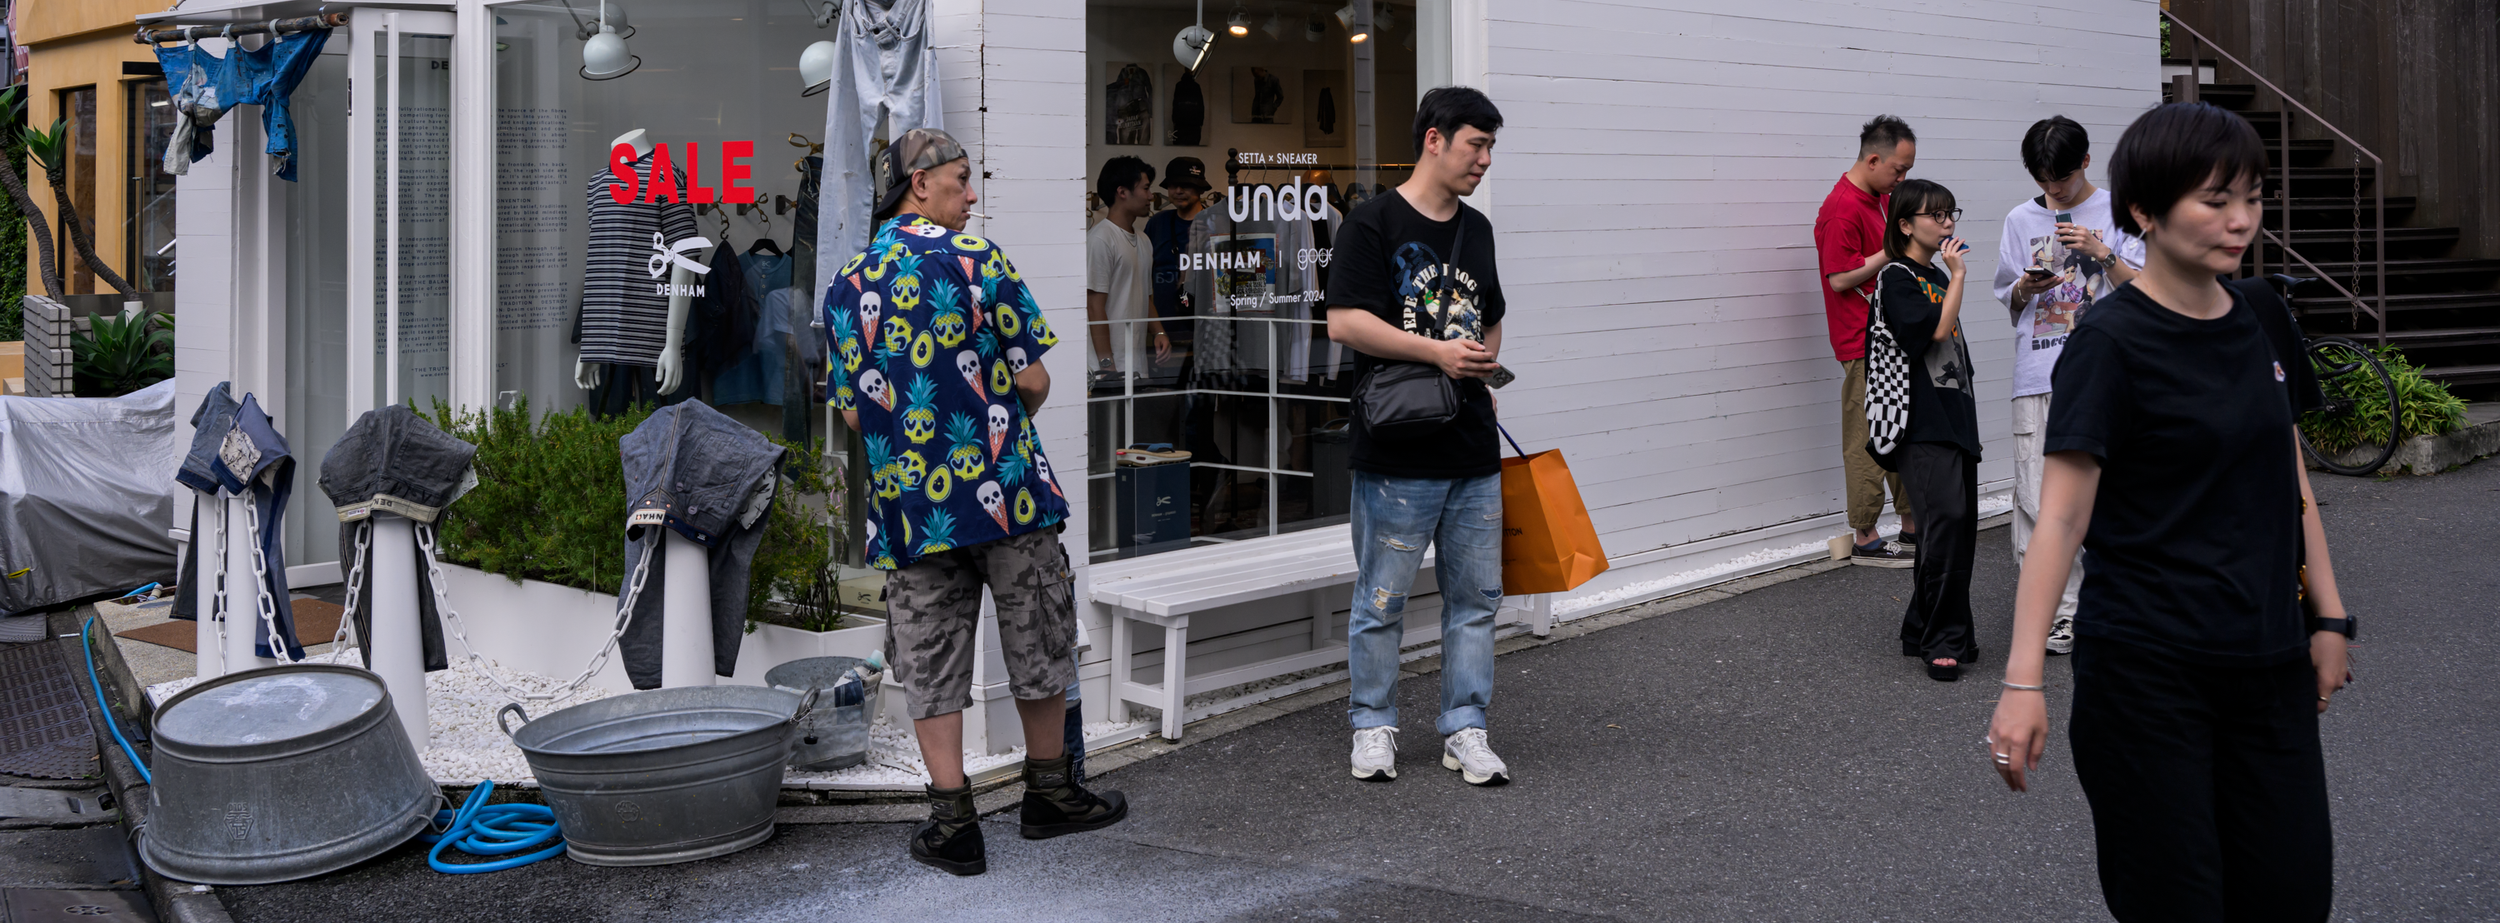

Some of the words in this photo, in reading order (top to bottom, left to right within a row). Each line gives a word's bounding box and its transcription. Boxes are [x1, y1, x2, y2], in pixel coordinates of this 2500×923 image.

[1238, 152, 1266, 164] SETTA
[1276, 152, 1318, 164] SNEAKER
[609, 140, 754, 205] SALE
[1228, 175, 1328, 223] unda
[1179, 250, 1261, 271] DENHAM
[1412, 264, 1438, 290] THE
[656, 283, 705, 297] DENHAM
[1230, 293, 1257, 309] Spring
[1269, 292, 1301, 304] Summer
[1303, 289, 1325, 302] 2024
